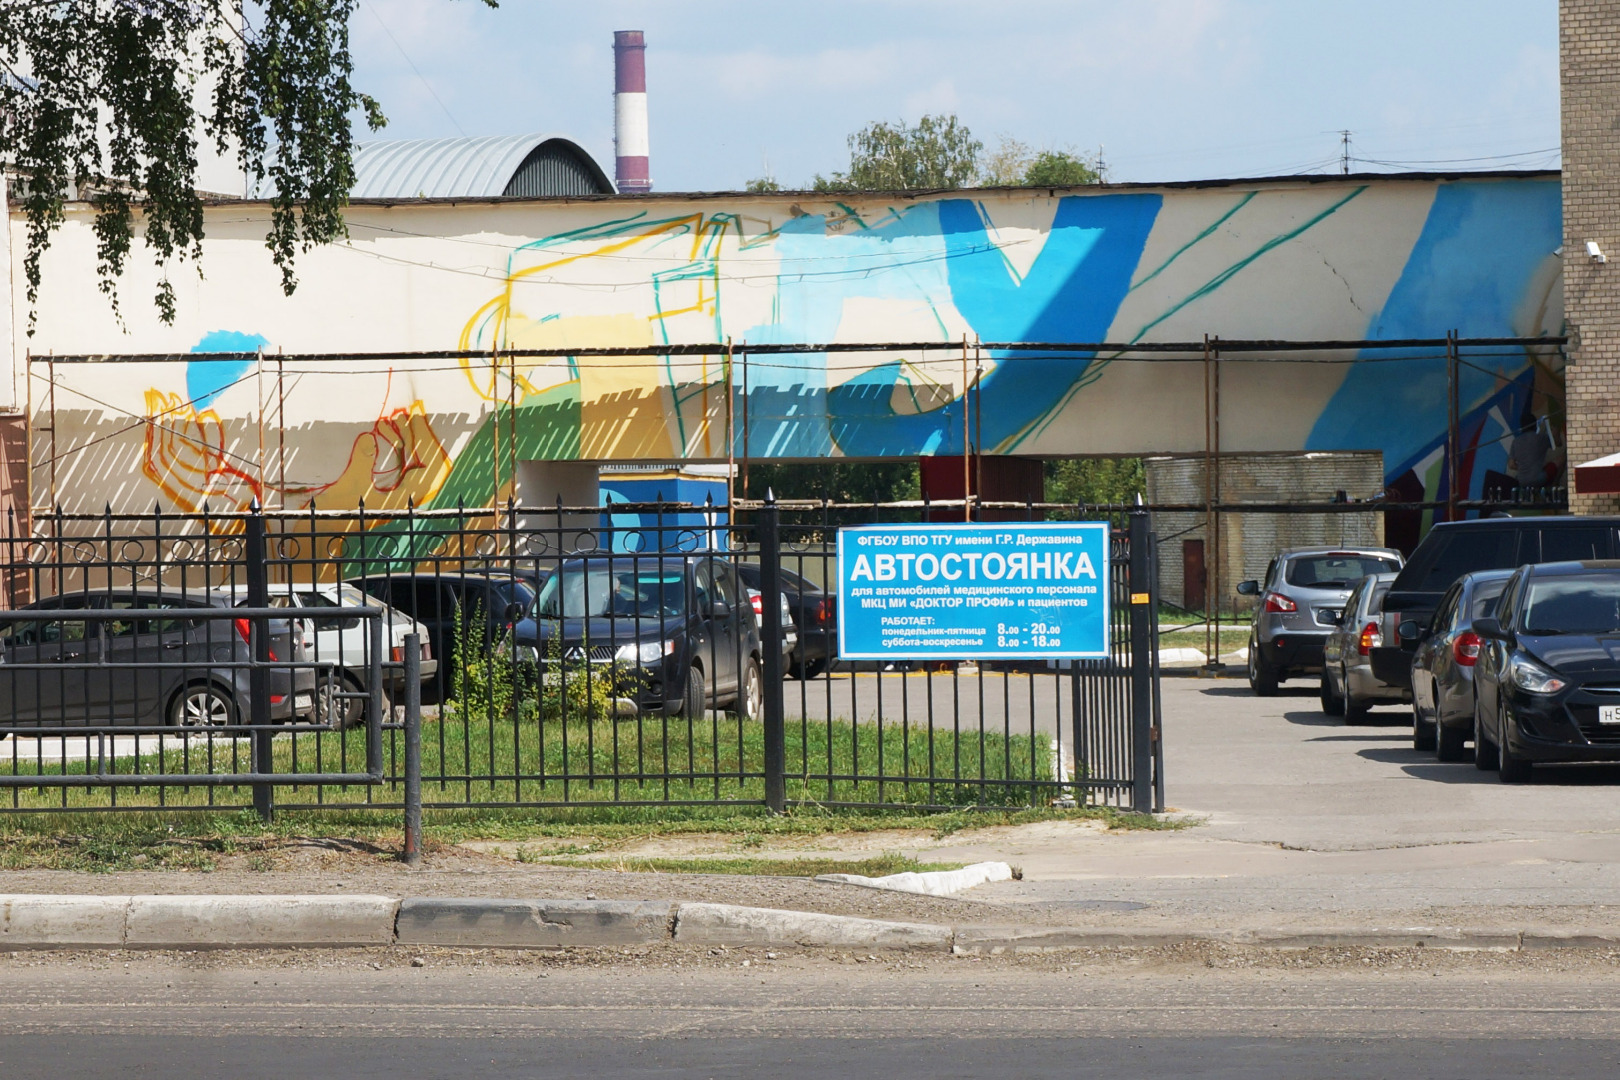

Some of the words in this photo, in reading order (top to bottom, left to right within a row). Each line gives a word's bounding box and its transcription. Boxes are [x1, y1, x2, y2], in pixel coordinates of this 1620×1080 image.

[857, 535, 899, 546] ФГБОУ
[901, 535, 929, 546] ВПО
[930, 535, 953, 546] ТГУ
[955, 536, 993, 545] имени
[995, 534, 1014, 545] Г.Р.
[1016, 534, 1083, 546] Державина
[850, 552, 1097, 581] АВТОСТОЯНКА
[851, 587, 873, 597] для
[875, 585, 951, 596] автомобилей
[953, 586, 1034, 596] медицинского
[1036, 585, 1097, 596] персонала
[861, 598, 887, 609] МКЦ
[888, 598, 907, 608] МИ
[1017, 598, 1025, 607] и
[1027, 598, 1088, 608] пациентов
[880, 616, 936, 626] РАБОТАЕТ:
[881, 627, 987, 636] понедельник-пятница
[997, 622, 1019, 635] 8.00
[1030, 622, 1061, 635] 20.00
[997, 635, 1019, 648] 8.00
[1030, 635, 1061, 648] 18.00
